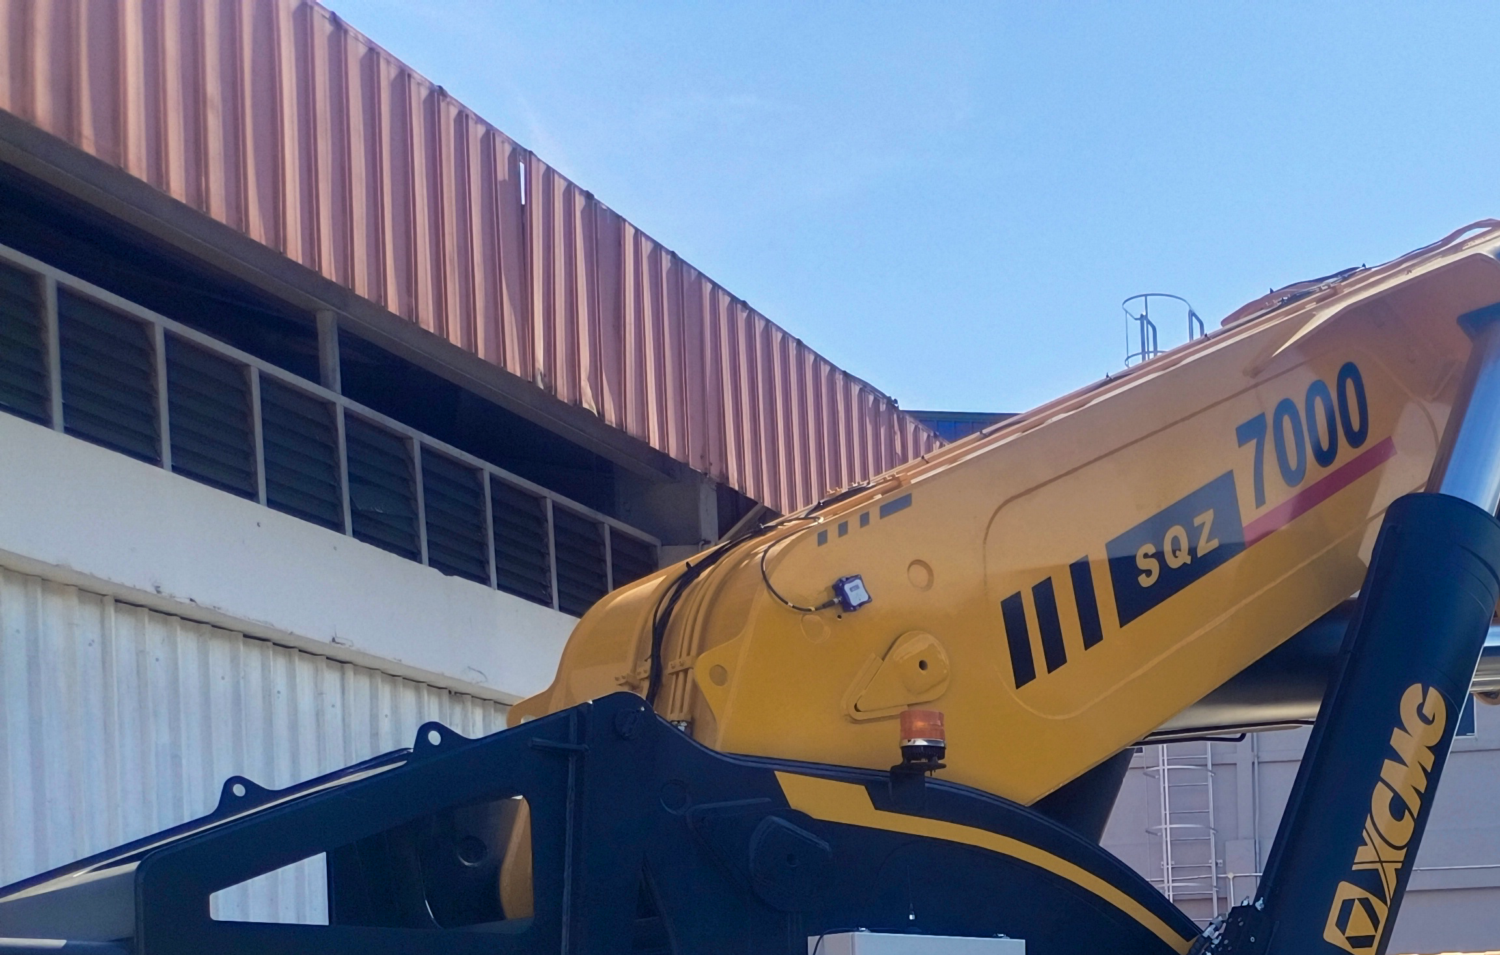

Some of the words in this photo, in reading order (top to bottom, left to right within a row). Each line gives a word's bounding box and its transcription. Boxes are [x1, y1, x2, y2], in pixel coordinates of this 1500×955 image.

[1135, 508, 1220, 588] SQZ
[1235, 361, 1369, 510] 7000
[1352, 682, 1447, 908] XCMG
